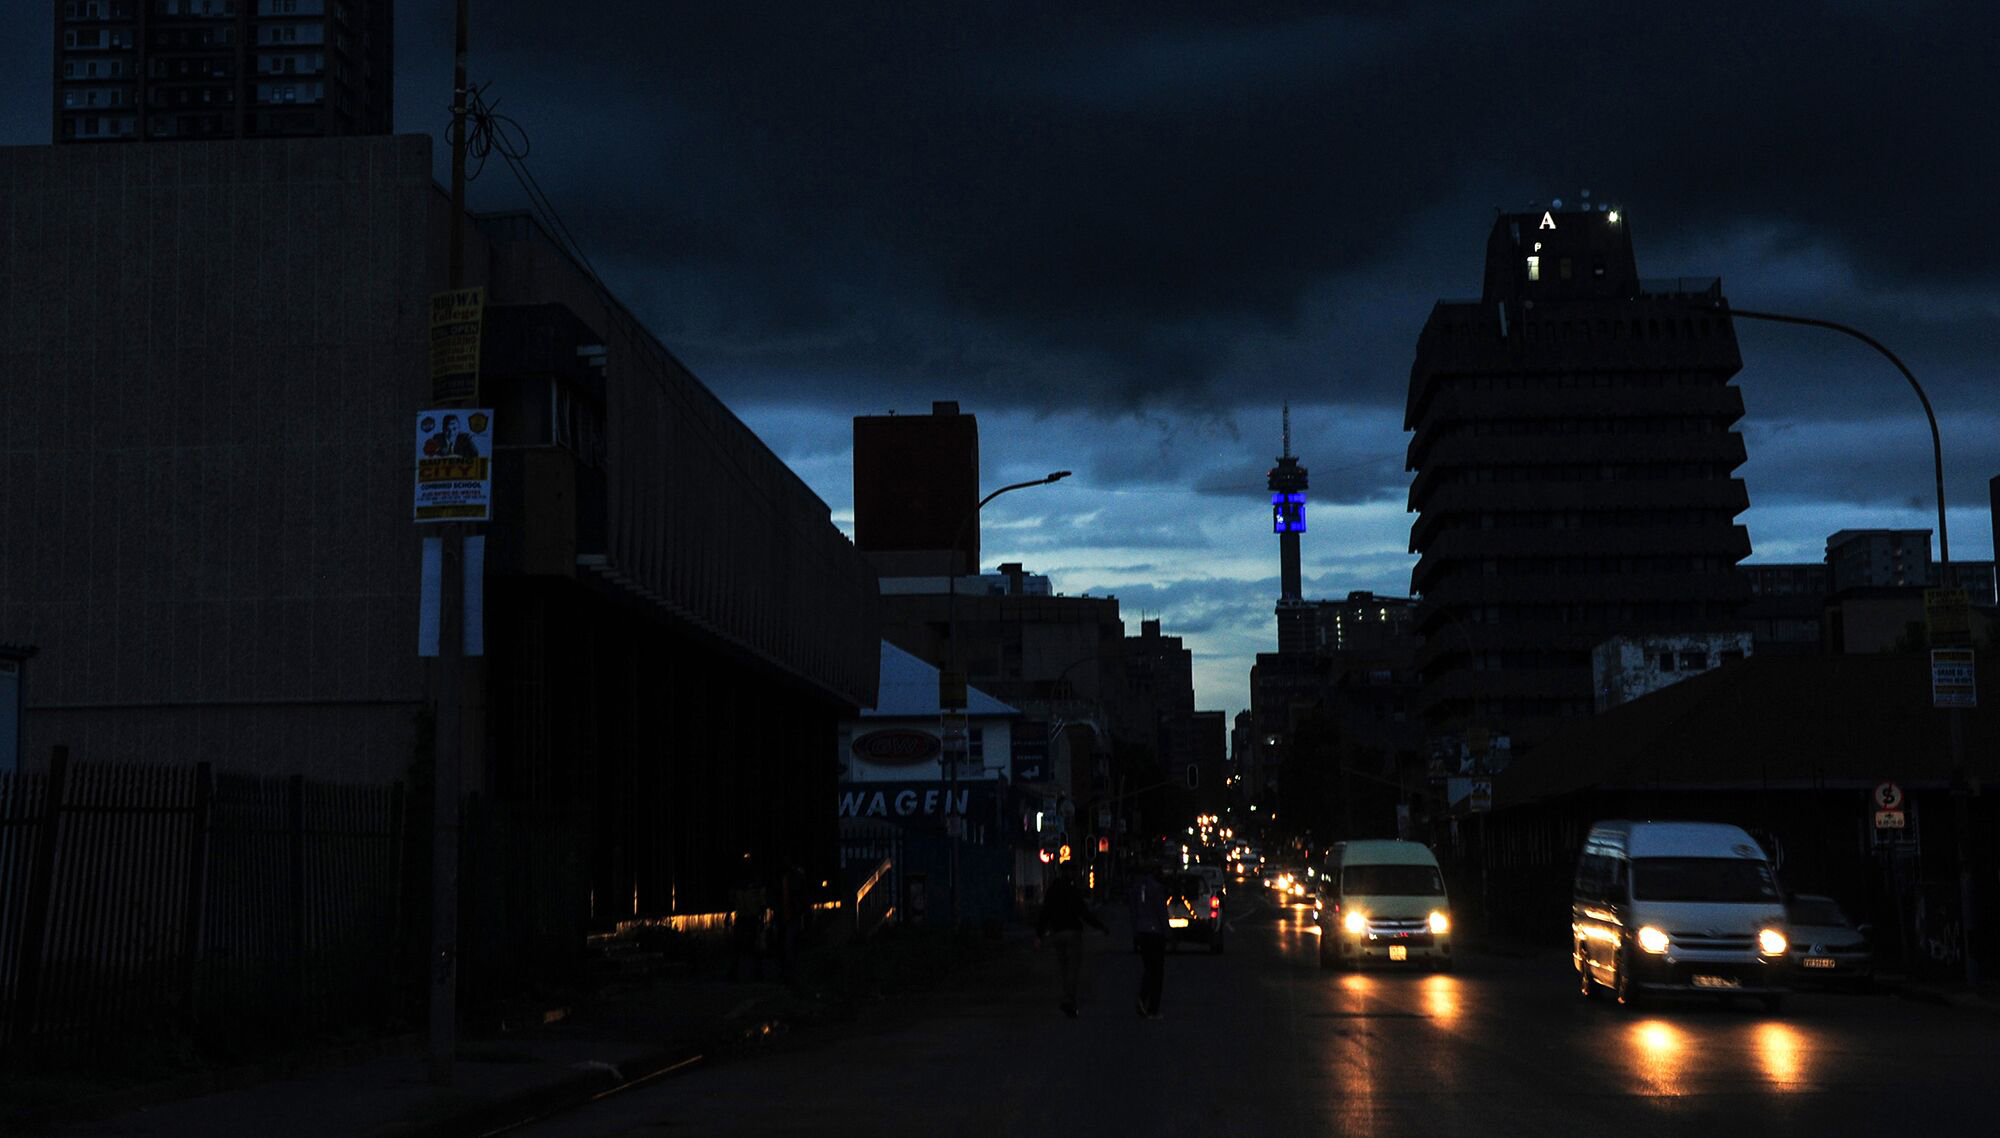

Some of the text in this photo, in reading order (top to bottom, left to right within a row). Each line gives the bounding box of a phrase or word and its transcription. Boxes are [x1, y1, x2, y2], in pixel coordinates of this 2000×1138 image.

[1538, 211, 1557, 230] A
[419, 465, 473, 478] CITY
[838, 789, 969, 816] WAGEN
